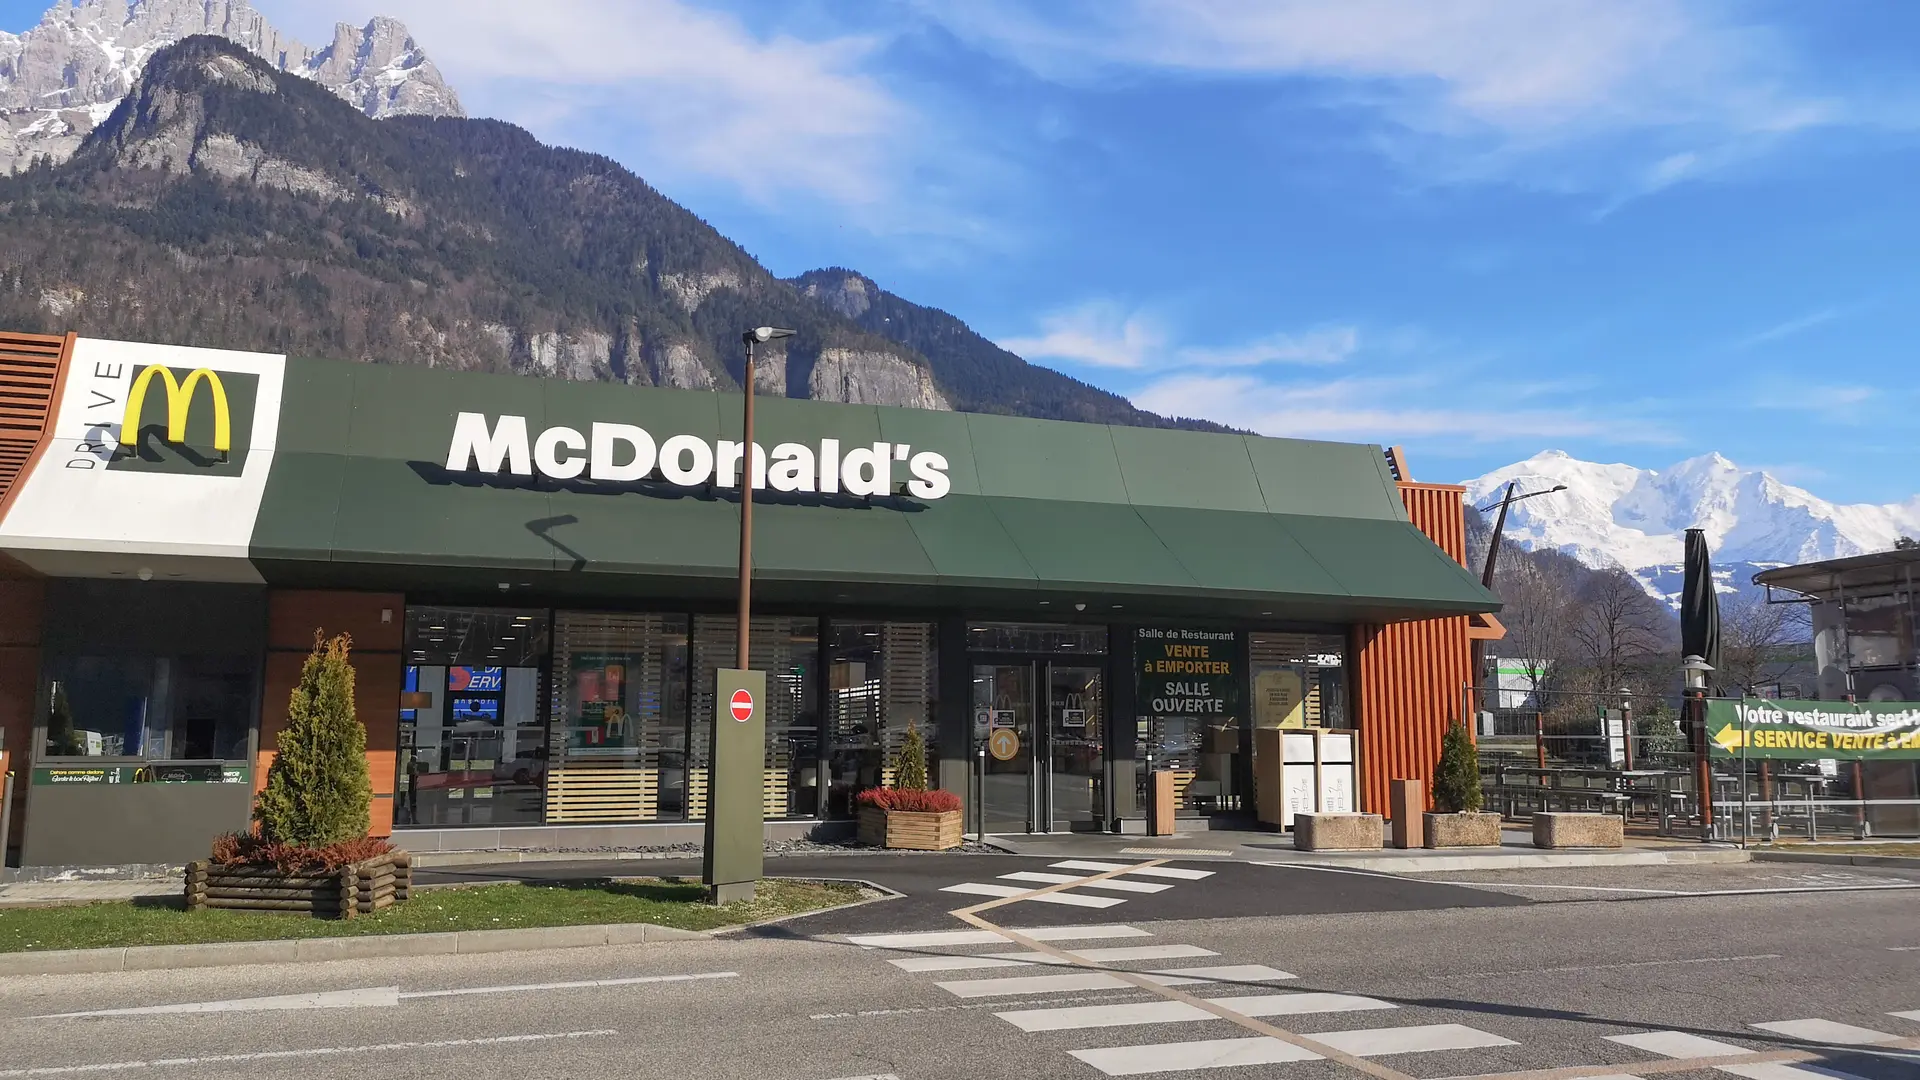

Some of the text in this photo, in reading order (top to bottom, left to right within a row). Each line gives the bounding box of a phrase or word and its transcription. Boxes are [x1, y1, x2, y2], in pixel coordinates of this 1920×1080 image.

[66, 362, 122, 469] DRIVE
[446, 411, 951, 499] McDonald's
[1139, 628, 1235, 640] Salle de Restaurant
[1164, 644, 1209, 658] VENTE
[1144, 660, 1230, 674] à EMPORTER
[1165, 682, 1210, 696] SALLE
[1152, 698, 1223, 713] OUVERTE
[1735, 704, 1783, 725] Votre
[1787, 707, 1873, 727] restaurant
[1754, 730, 1826, 748] SERVICE
[1830, 731, 1885, 749] VENTE
